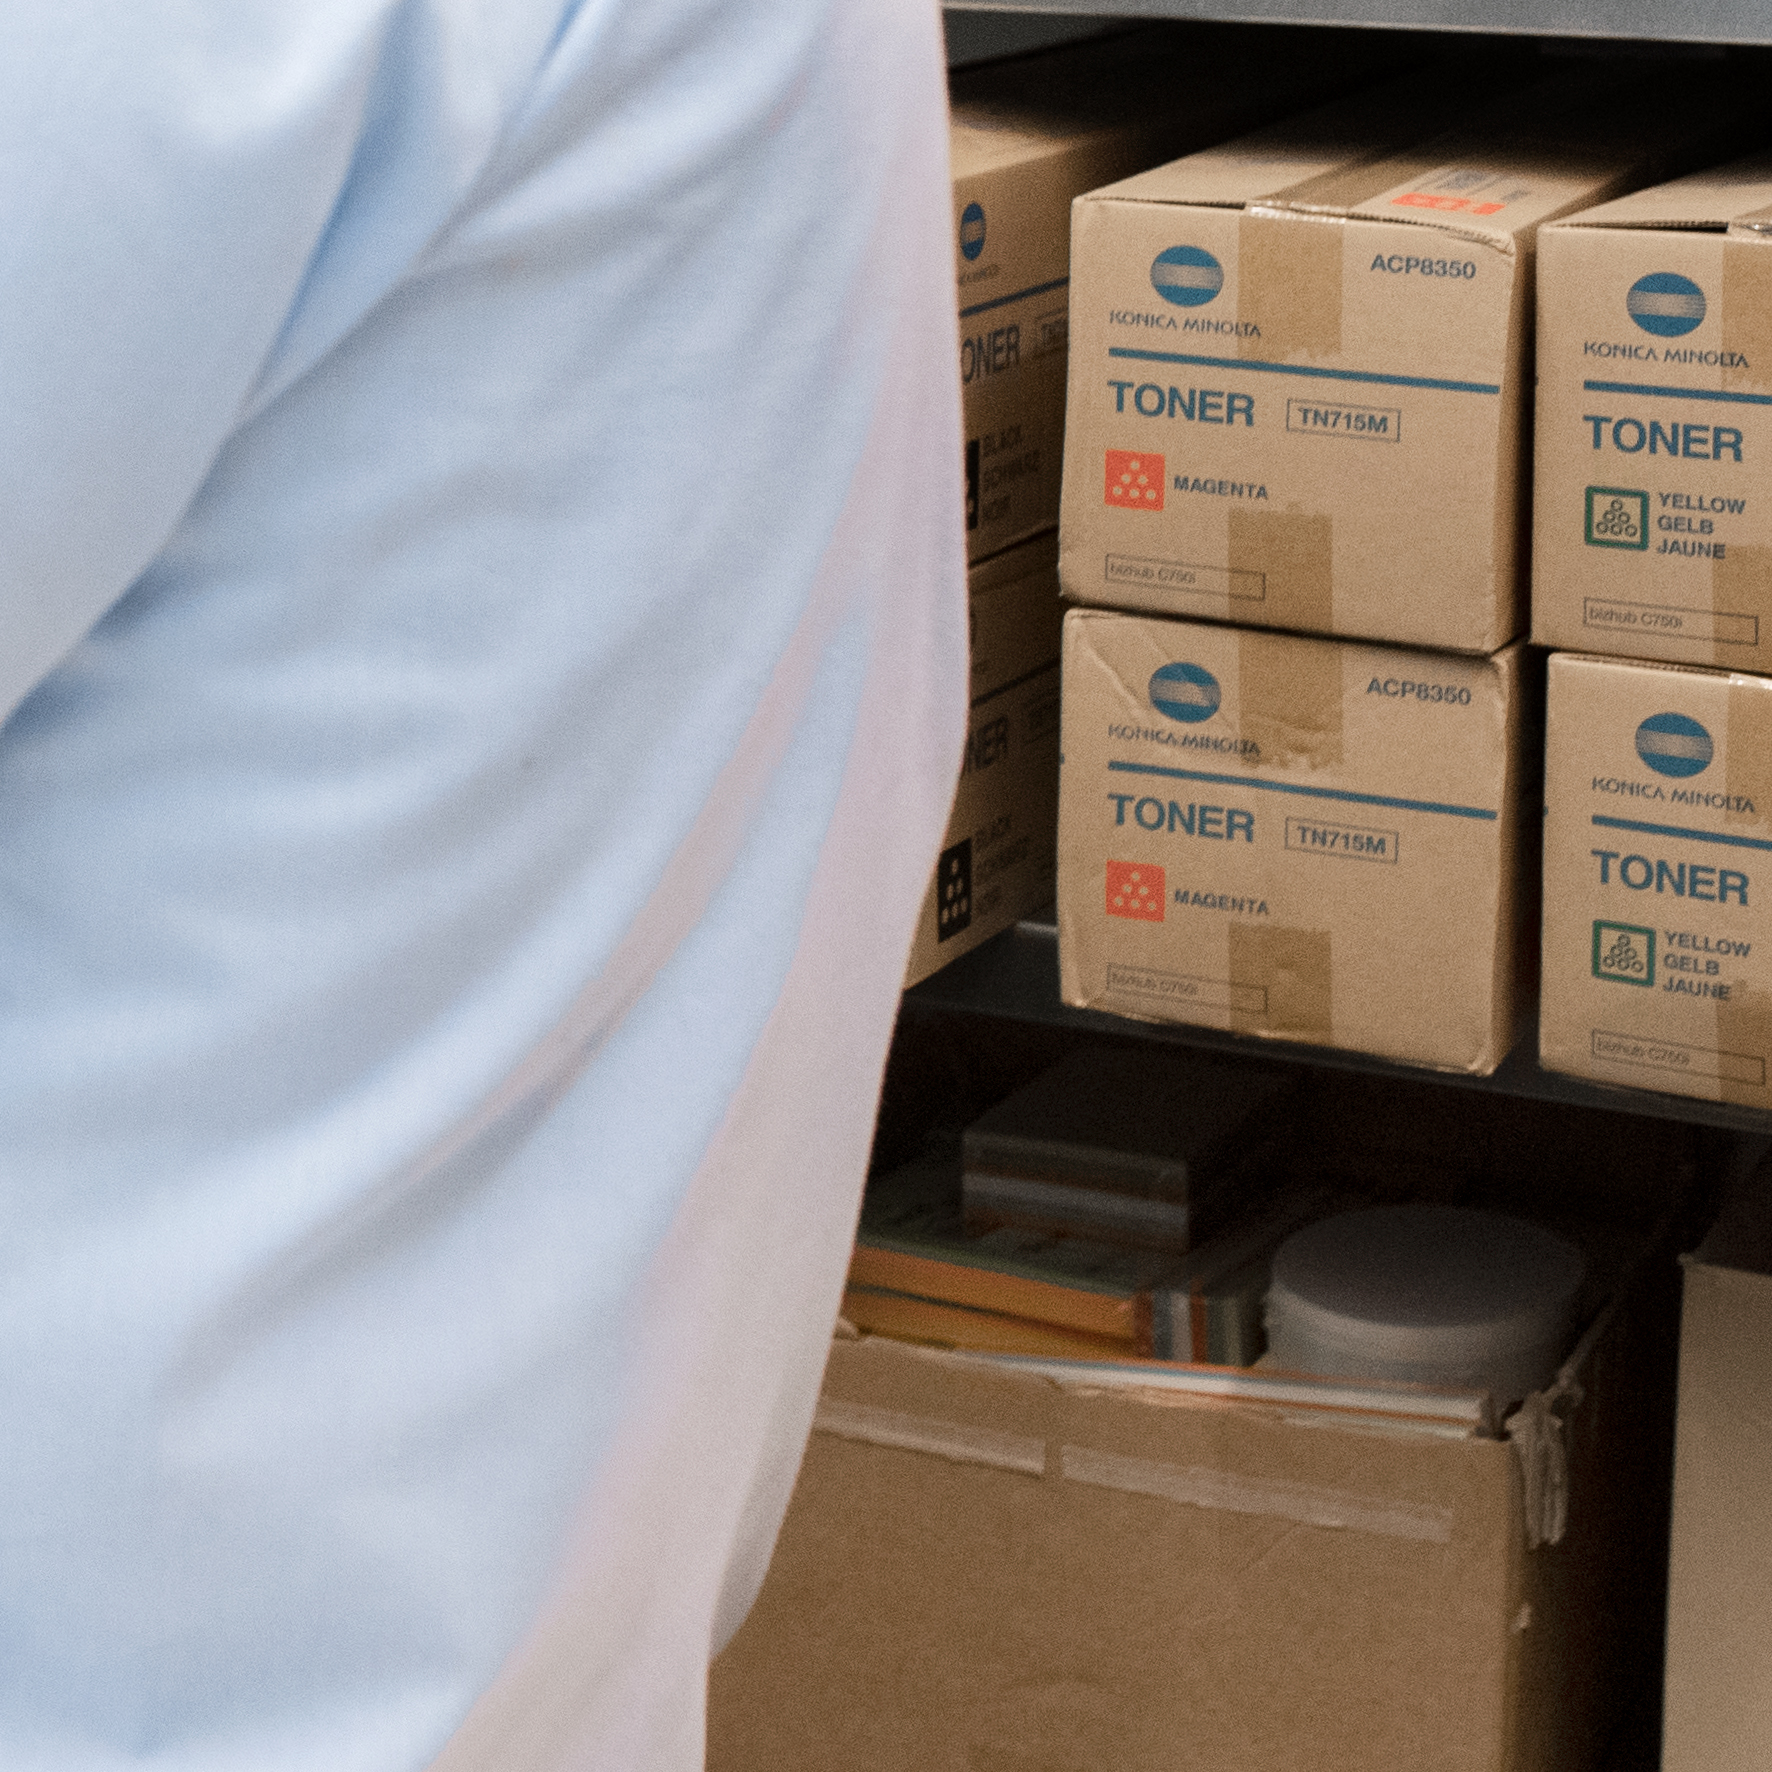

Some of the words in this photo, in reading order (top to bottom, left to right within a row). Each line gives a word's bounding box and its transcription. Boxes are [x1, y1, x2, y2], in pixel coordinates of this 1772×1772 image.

[1370, 253, 1477, 280] ACP8350
[1109, 309, 1177, 332] KONICA
[1183, 317, 1261, 339] MINOLTA
[1583, 340, 1658, 362] KONICA
[1663, 348, 1750, 369] MINOLTA
[1107, 380, 1255, 428] TONER
[1297, 406, 1389, 434] TN715M
[1583, 414, 1744, 463] TONER
[1173, 474, 1269, 501] MAGENTA
[1658, 491, 1746, 515] YELLOW
[1657, 514, 1714, 536] GELB
[1657, 538, 1726, 560] JAUNE
[1588, 603, 1638, 625] bizhub
[1366, 677, 1472, 707] ACP8350
[1108, 724, 1178, 747] KONICA
[1182, 733, 1261, 758] MINOLTA
[1592, 777, 1666, 802] KONICA
[1671, 787, 1756, 814] MINOLTA
[1107, 793, 1255, 844] TONER
[1296, 825, 1388, 856] TN715M
[1591, 849, 1749, 906] TONER
[1174, 888, 1269, 916] MAGENTA
[1664, 930, 1751, 959] YELLOW
[1663, 952, 1720, 977] GELB
[1663, 976, 1731, 1002] JAUNE
